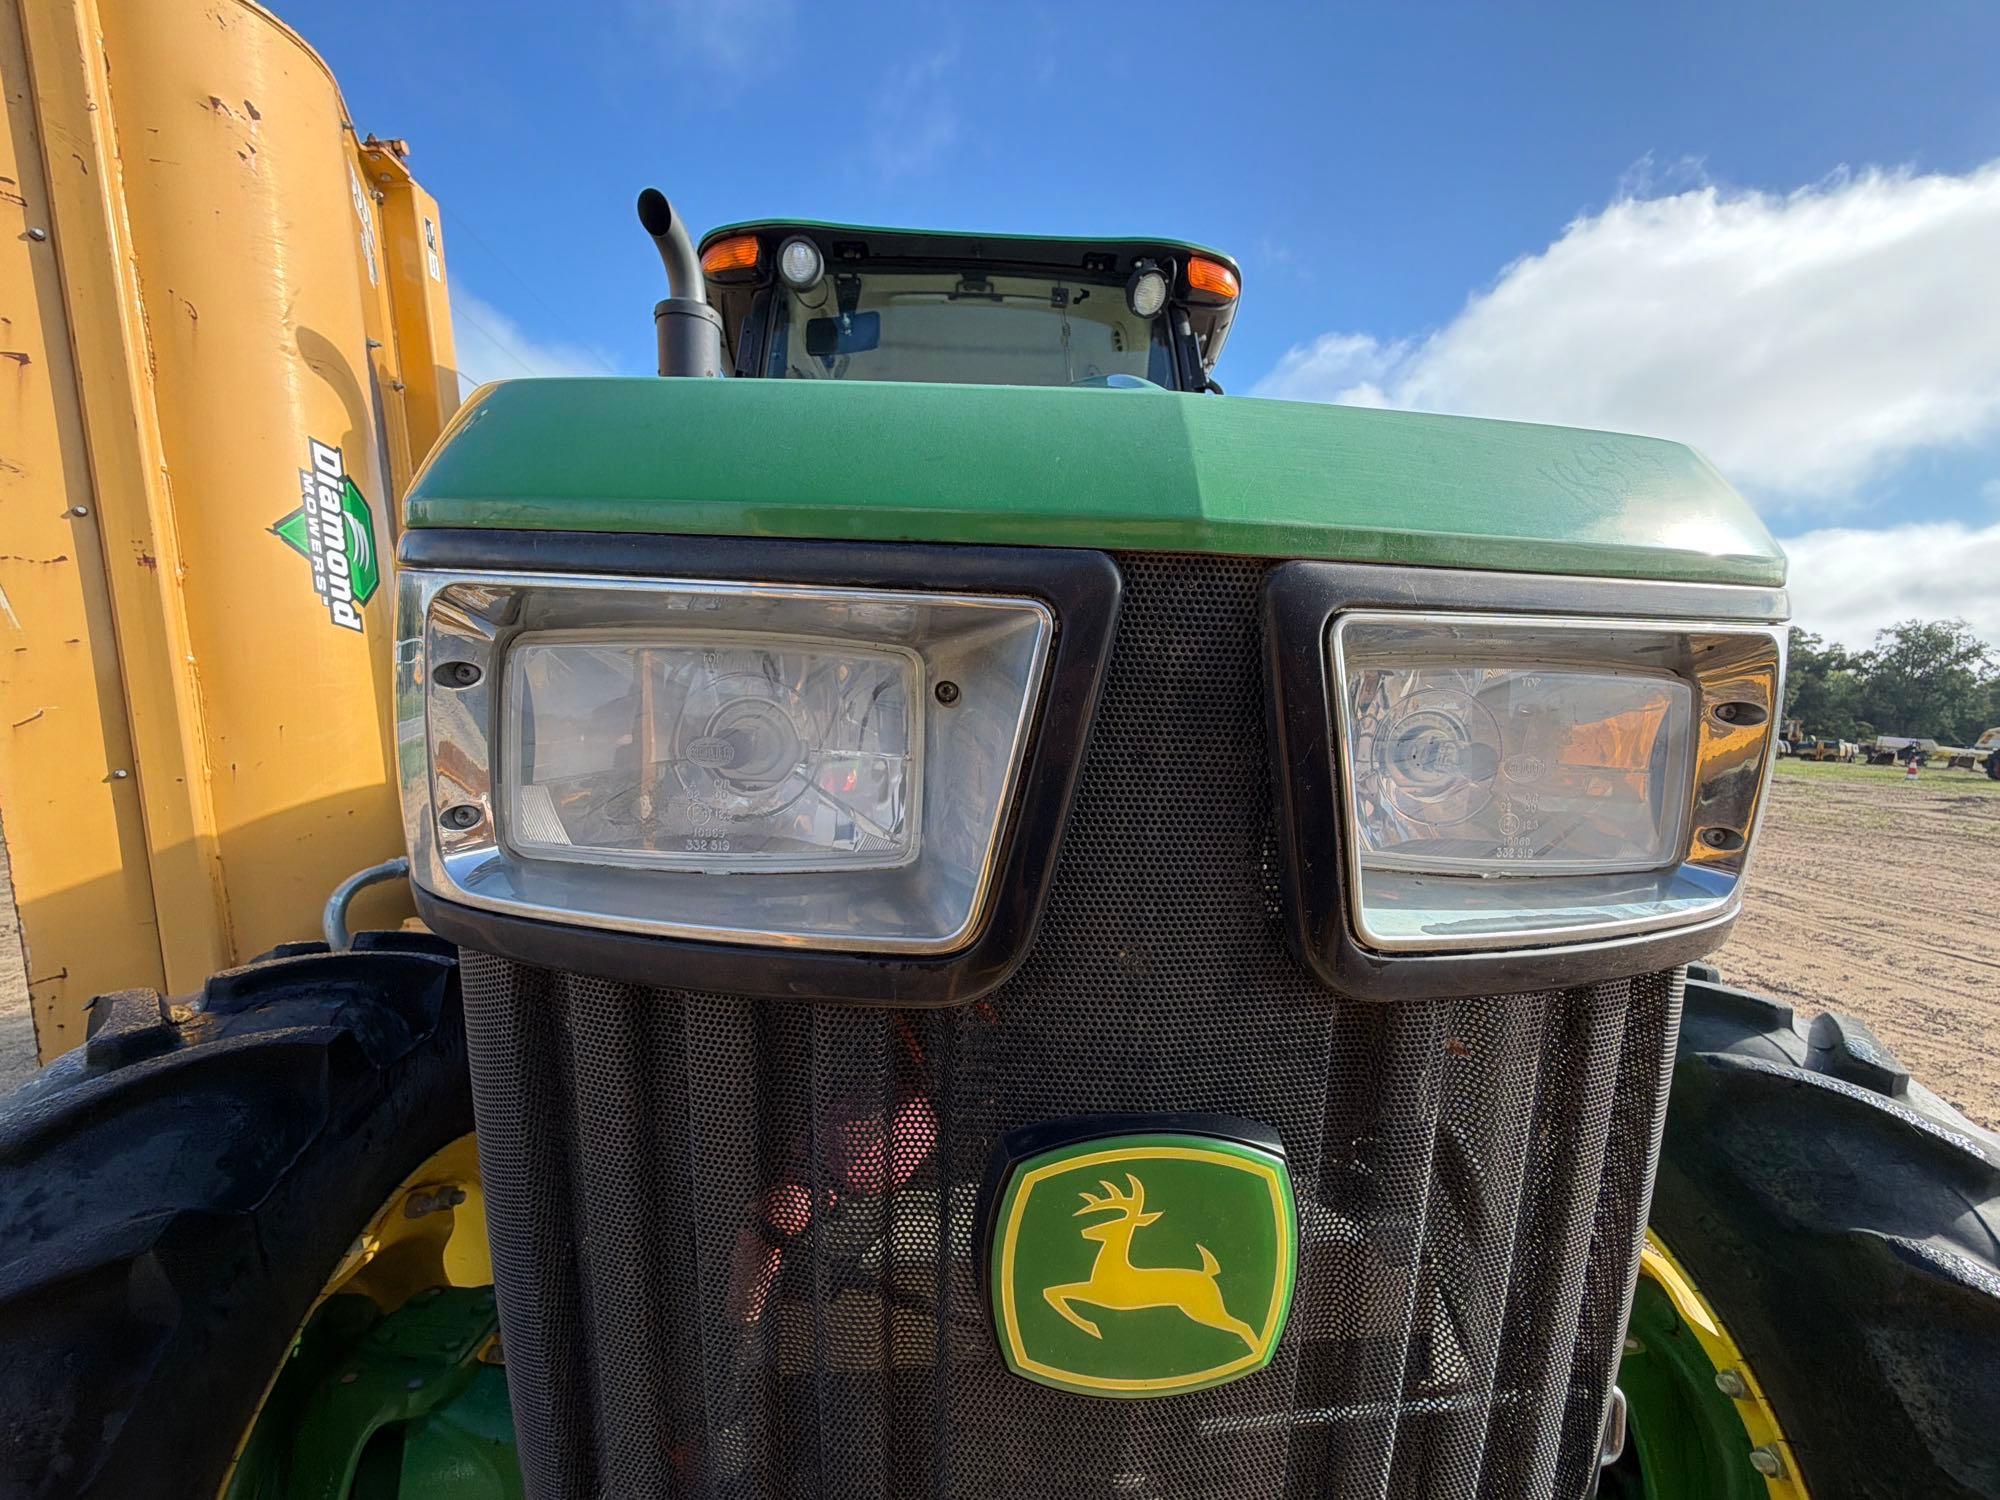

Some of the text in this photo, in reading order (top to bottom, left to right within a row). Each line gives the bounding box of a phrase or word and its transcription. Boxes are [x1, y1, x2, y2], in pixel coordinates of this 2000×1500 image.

[302, 473, 327, 592] MOWERS
[312, 441, 361, 632] Diamond
[686, 839, 707, 851] 332
[1496, 847, 1514, 858] 332
